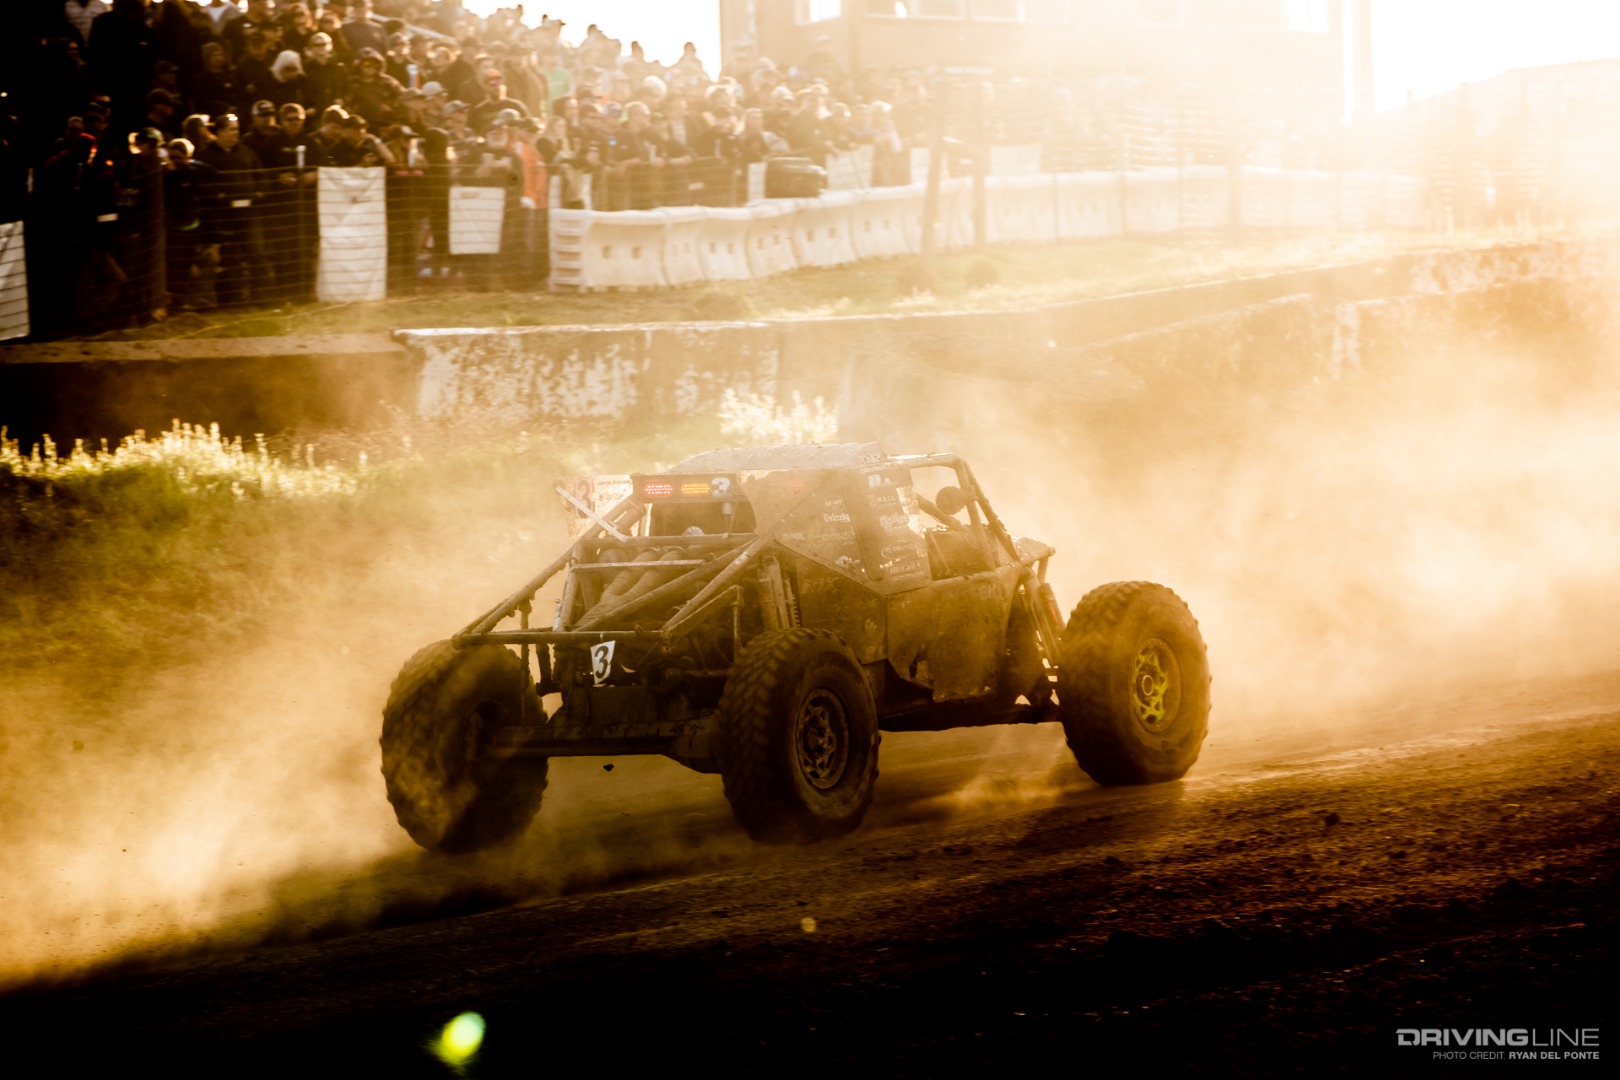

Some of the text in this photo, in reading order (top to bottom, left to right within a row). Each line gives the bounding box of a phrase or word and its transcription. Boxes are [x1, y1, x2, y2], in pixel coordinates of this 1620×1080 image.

[575, 479, 593, 520] 3
[712, 477, 731, 497] 3
[594, 645, 609, 680] 3
